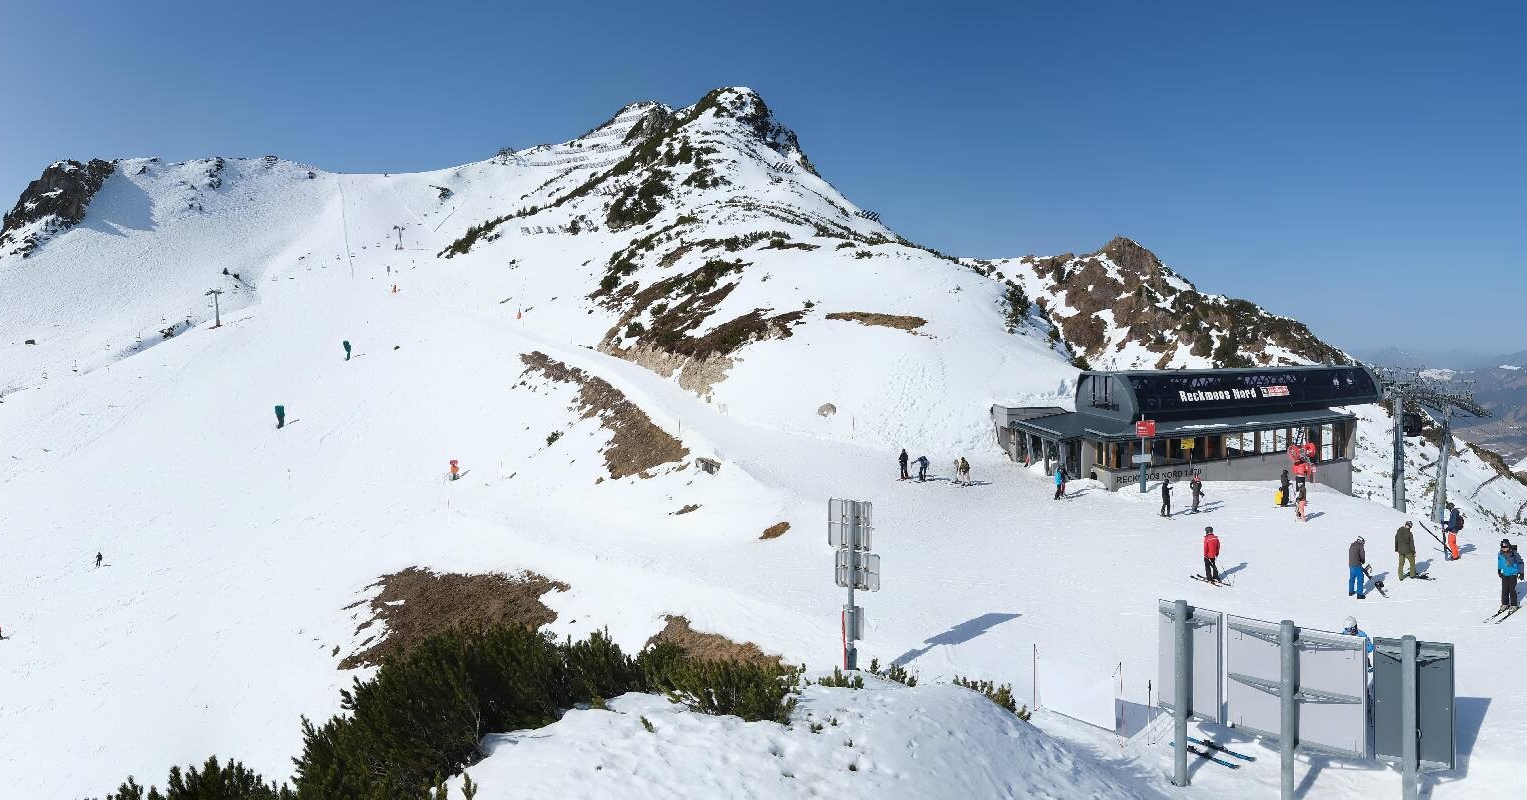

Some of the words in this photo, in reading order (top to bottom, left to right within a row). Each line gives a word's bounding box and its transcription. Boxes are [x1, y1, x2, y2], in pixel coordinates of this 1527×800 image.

[1179, 389, 1231, 402] Reckmoos
[1232, 387, 1257, 400] Nord
[1116, 472, 1160, 484] RECKOOS
[1161, 469, 1183, 479] NORD
